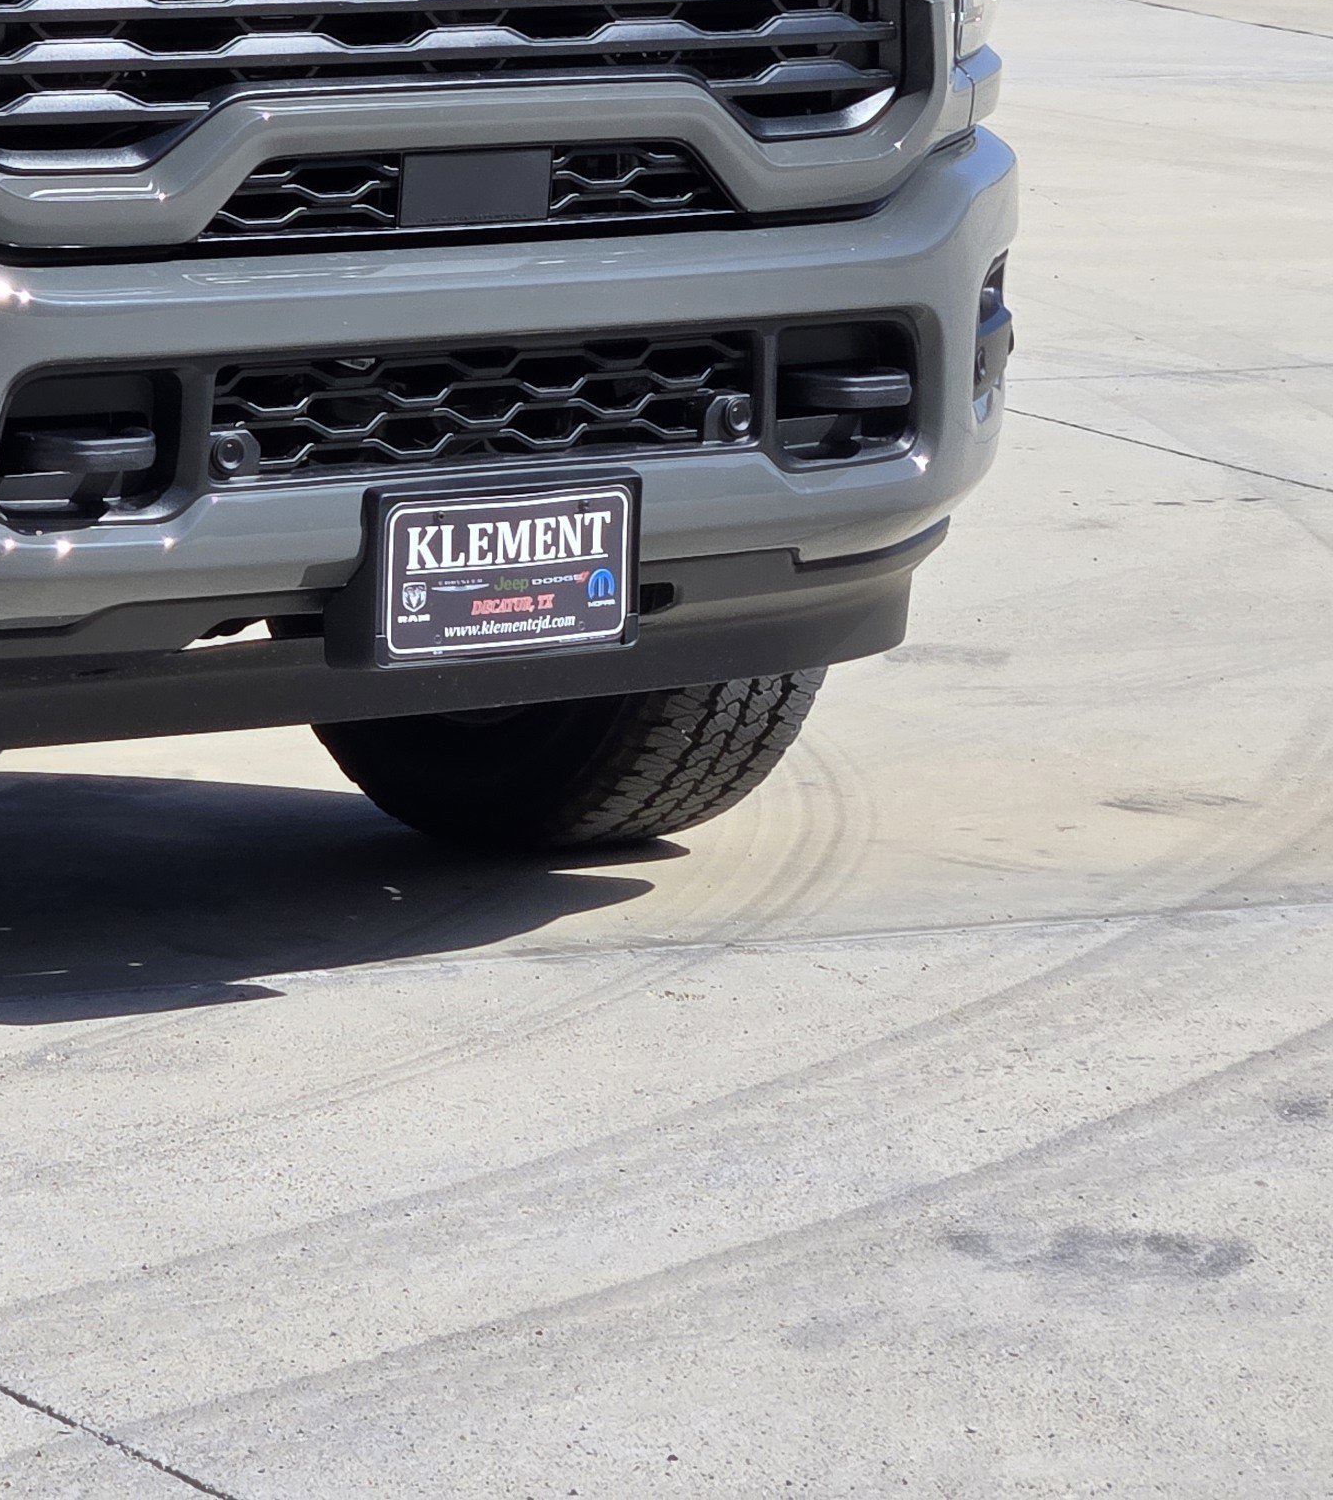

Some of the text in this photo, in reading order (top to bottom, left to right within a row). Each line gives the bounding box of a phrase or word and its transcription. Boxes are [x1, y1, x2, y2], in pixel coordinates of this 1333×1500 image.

[406, 511, 612, 570] KLEMENT
[494, 575, 529, 593] Jeep
[531, 573, 583, 586] DODGE
[537, 594, 556, 610] TX
[397, 613, 431, 623] RAM
[444, 614, 576, 638] www.klementcjd.com
